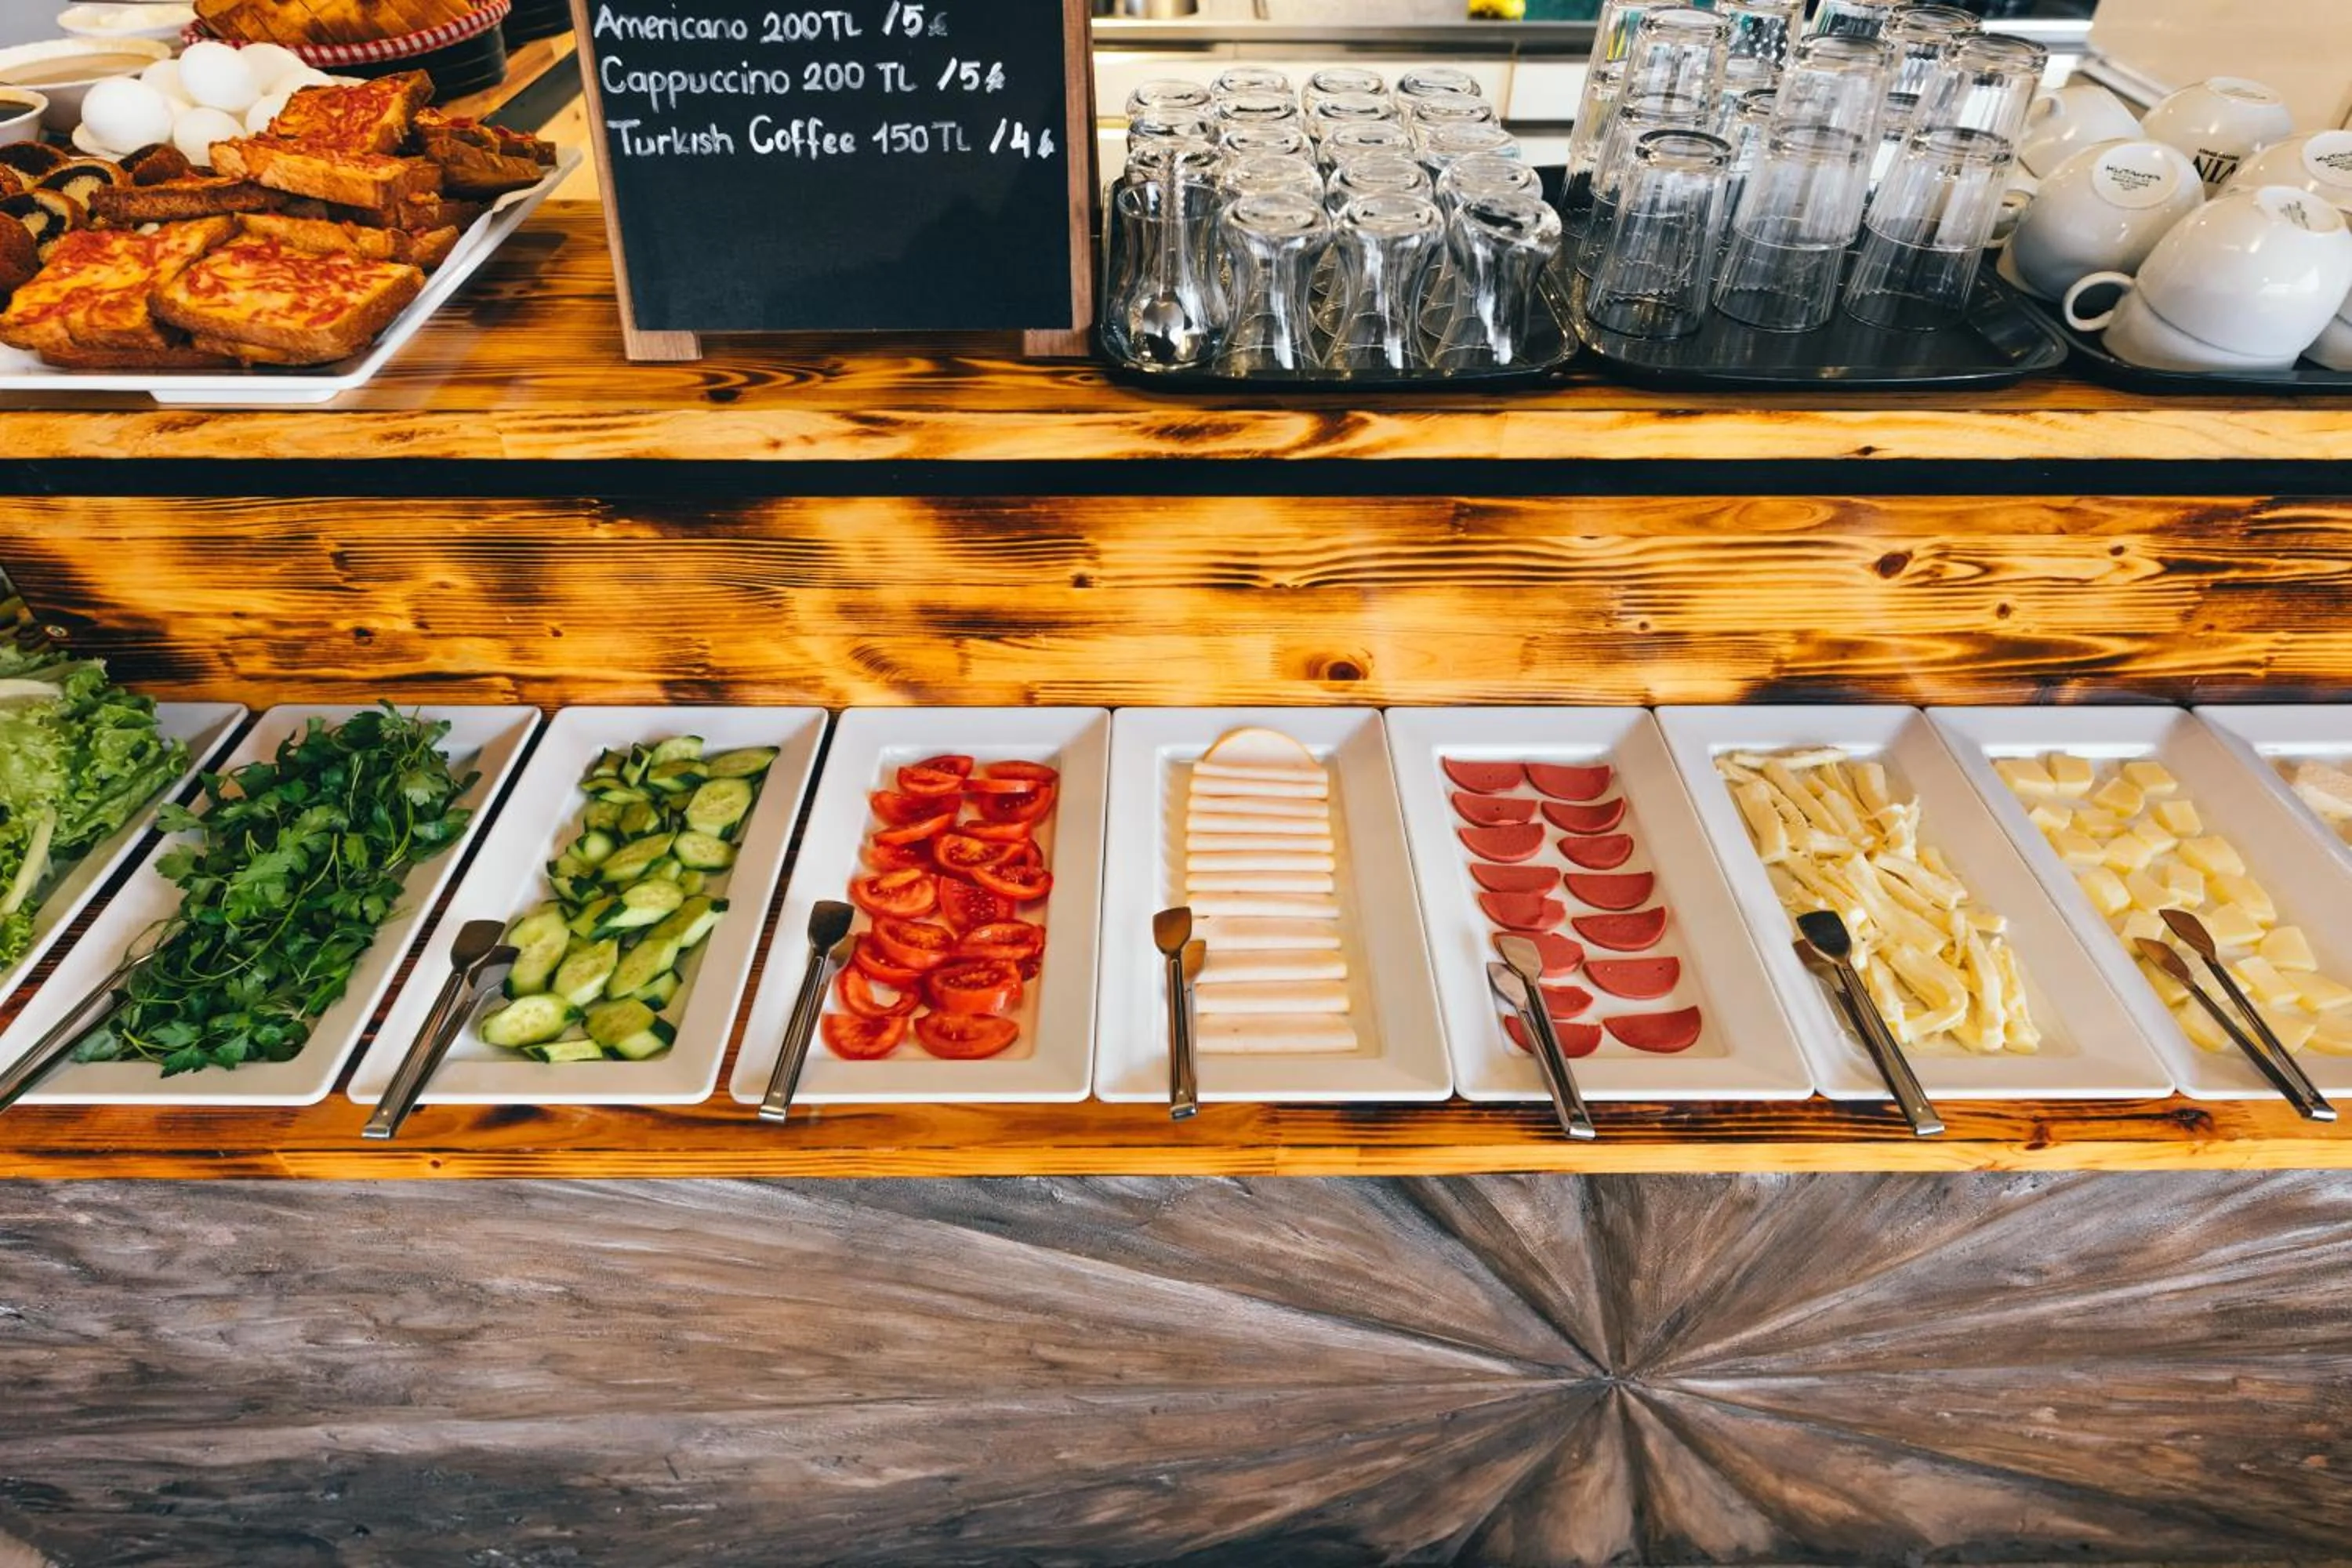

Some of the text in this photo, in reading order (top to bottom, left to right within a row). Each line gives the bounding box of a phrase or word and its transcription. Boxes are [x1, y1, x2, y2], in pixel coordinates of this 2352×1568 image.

[593, 3, 748, 41] Americano
[601, 56, 790, 113] Cappuccino
[802, 61, 865, 92] 200
[874, 62, 918, 93] TL
[607, 118, 735, 155] Turkish
[749, 114, 857, 160] Coffee
